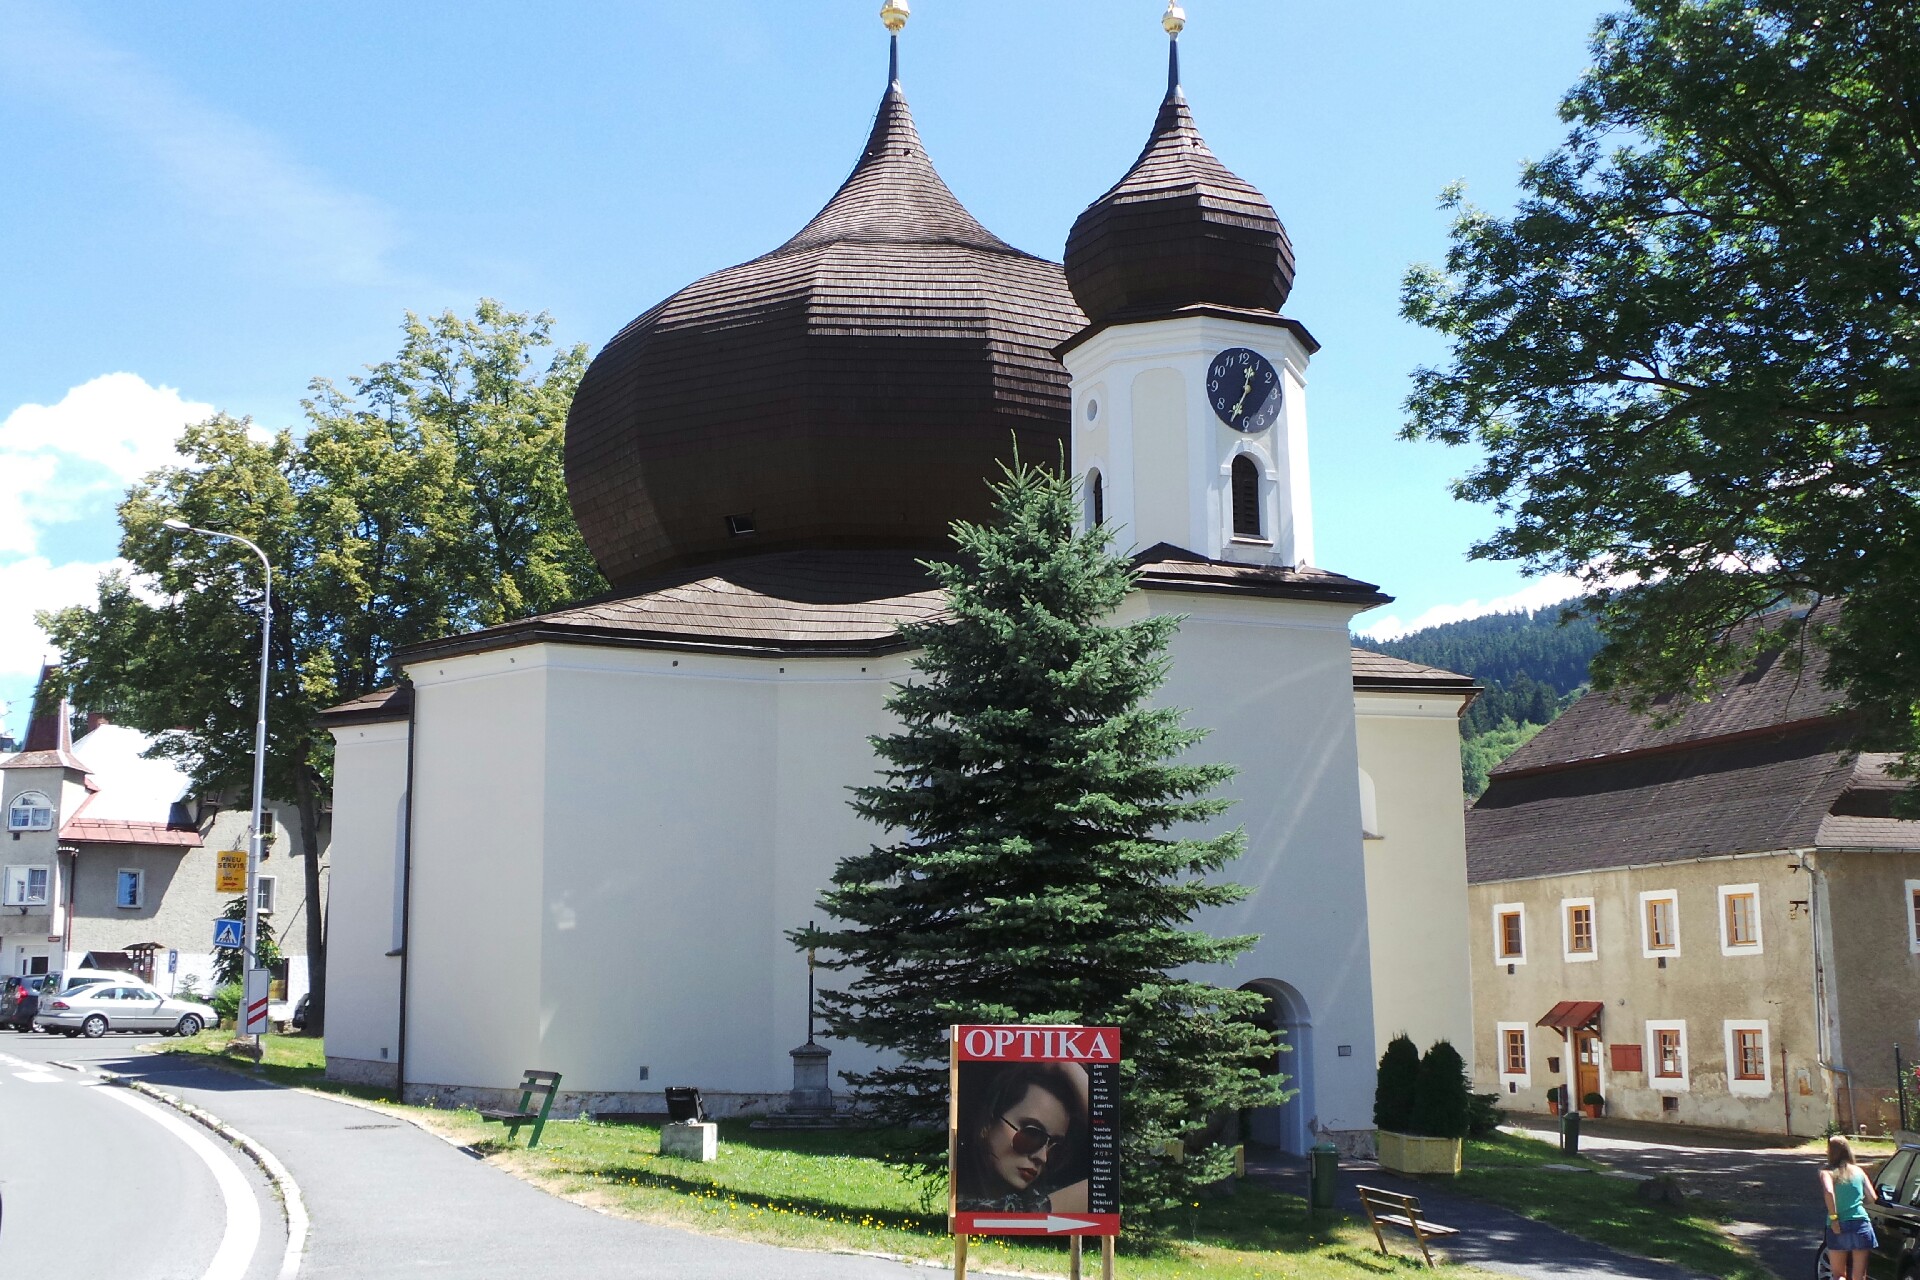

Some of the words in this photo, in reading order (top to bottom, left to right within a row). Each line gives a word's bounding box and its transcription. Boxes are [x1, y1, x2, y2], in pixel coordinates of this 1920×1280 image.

[1225, 355, 1234, 368] 11
[1239, 352, 1250, 365] 12
[1255, 359, 1260, 371] 1
[1213, 365, 1226, 378] 10
[1264, 371, 1273, 384] 2
[1211, 380, 1219, 392] 9
[1270, 388, 1278, 400] 3
[1217, 397, 1225, 410] 8
[1267, 405, 1274, 416] 4
[1242, 416, 1250, 429] 6
[1256, 414, 1265, 426] 5
[964, 1029, 1113, 1059] OPTIKA
